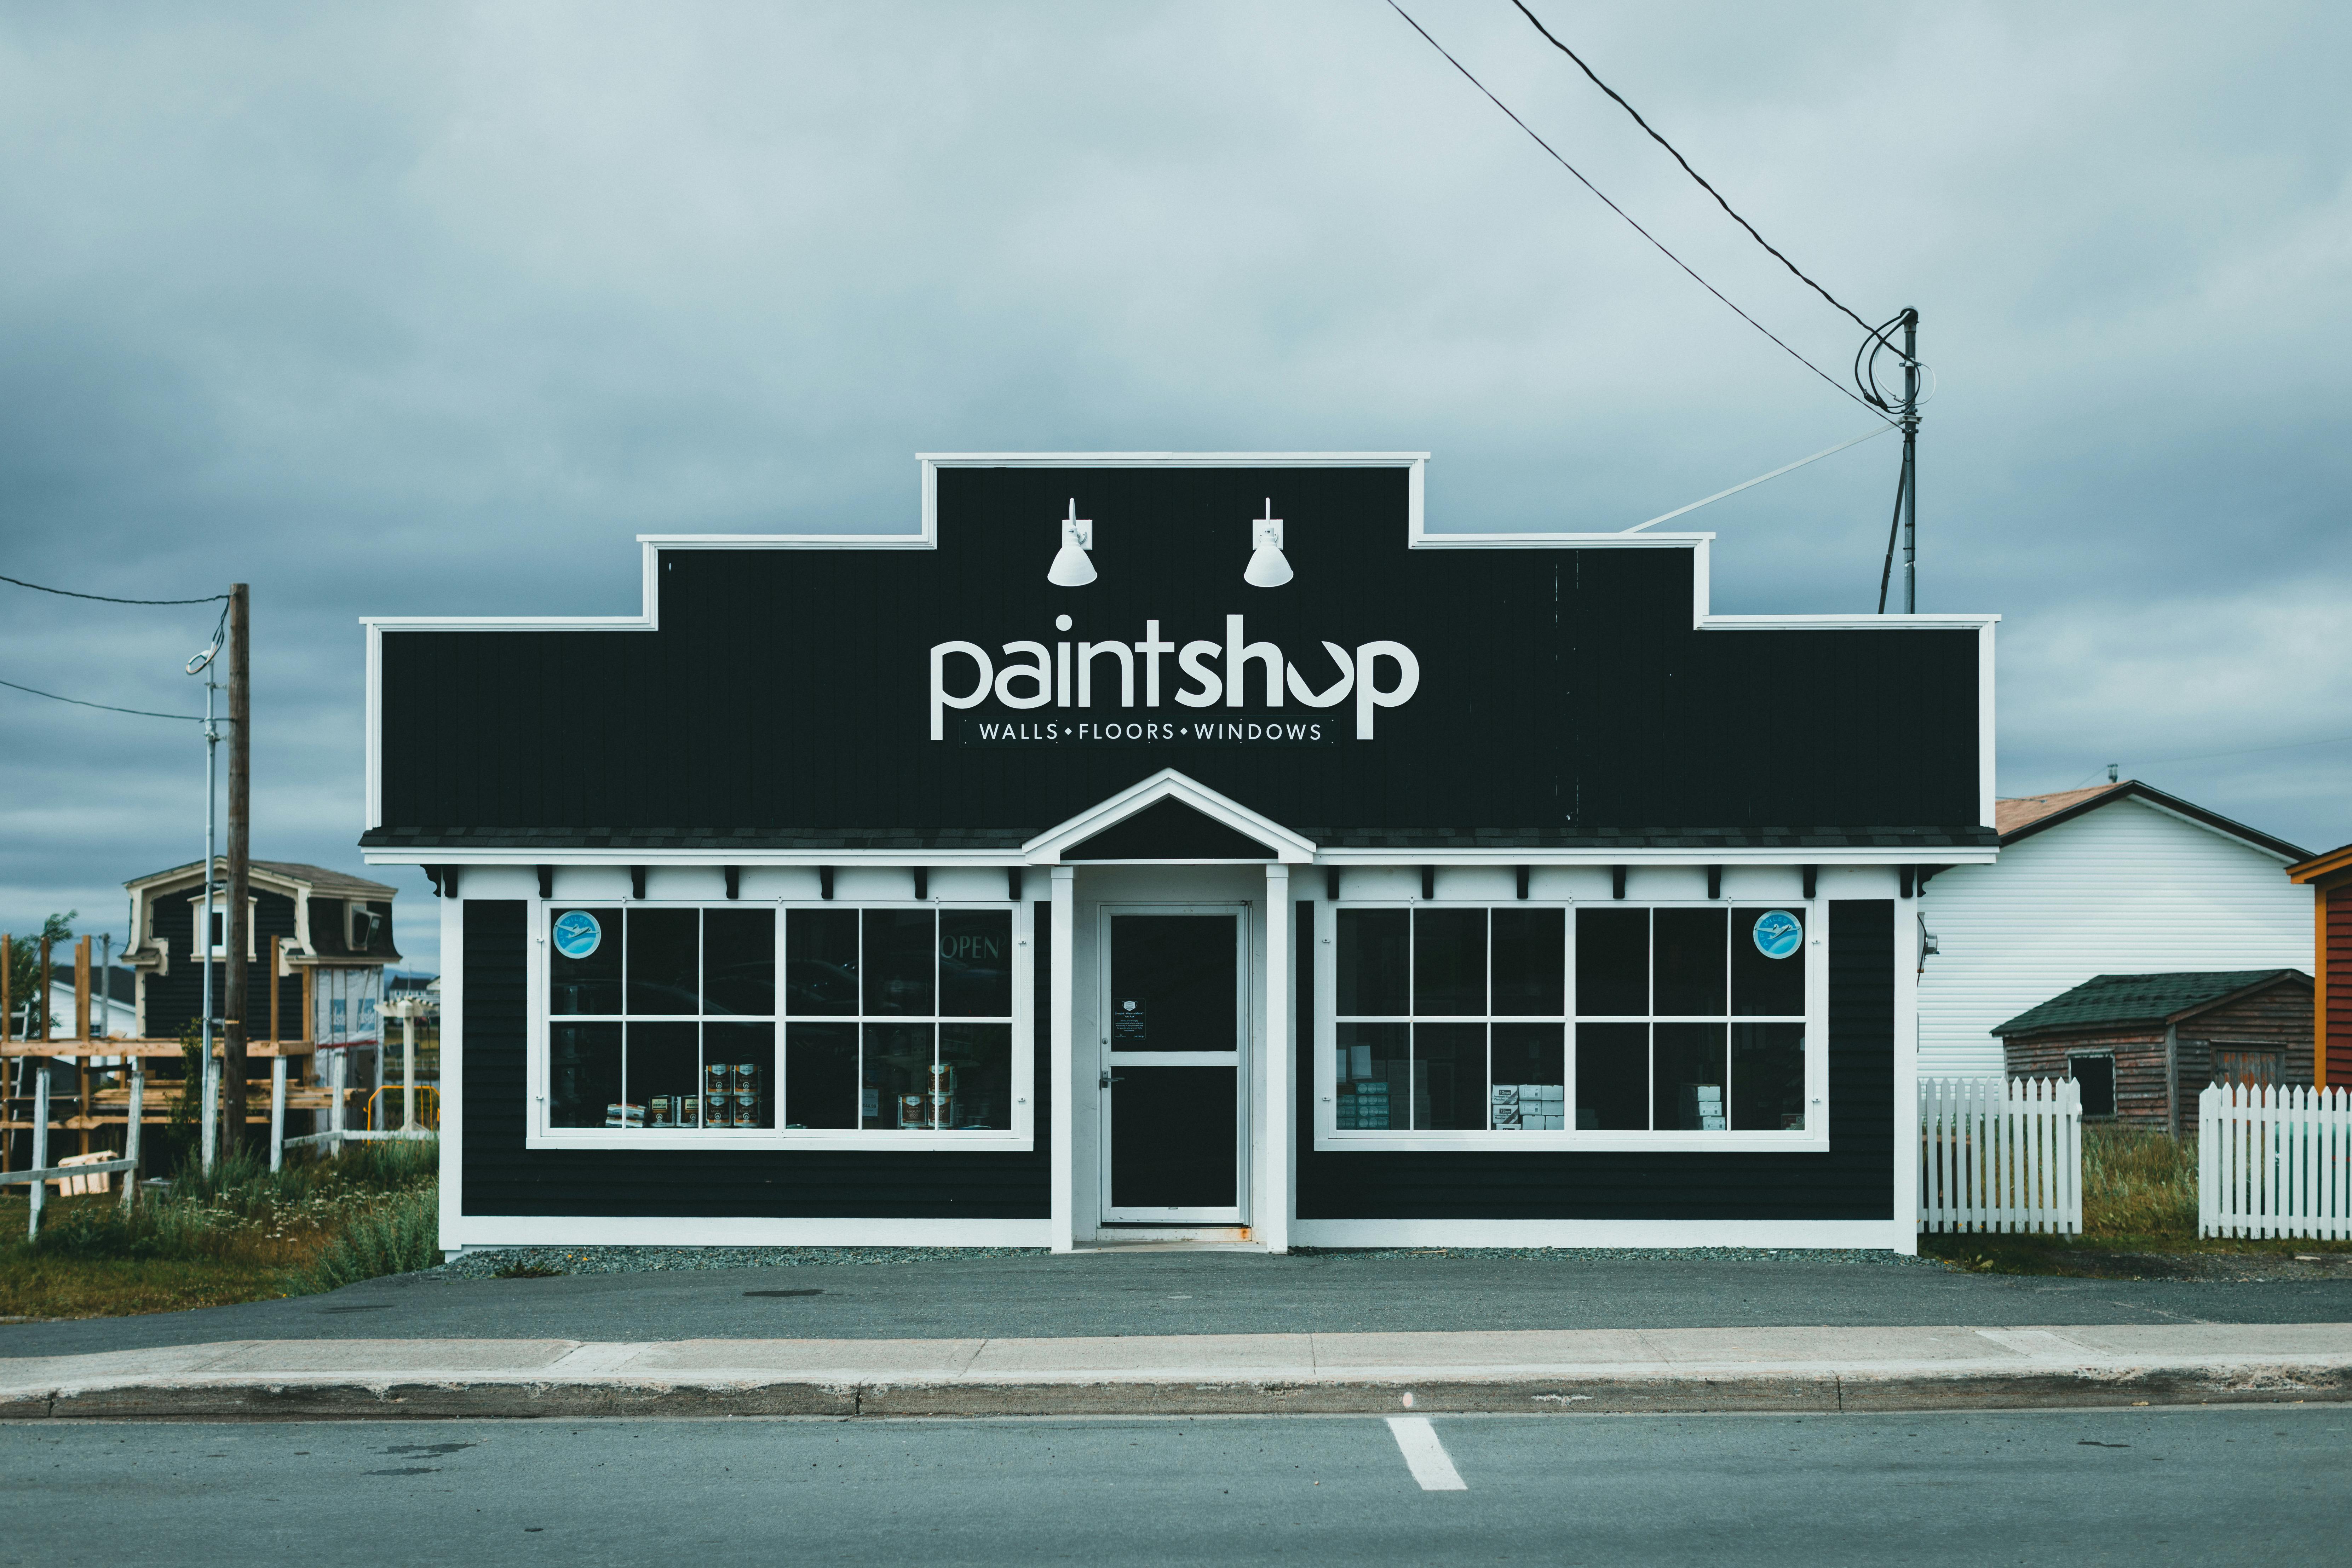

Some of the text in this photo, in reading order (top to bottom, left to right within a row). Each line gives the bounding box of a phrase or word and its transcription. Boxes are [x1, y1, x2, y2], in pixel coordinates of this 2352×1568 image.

[931, 614, 1420, 740] paintshop
[979, 724, 1321, 740] WALLS FLOORS WINDOWS
[1760, 917, 1788, 946] AIR MILES
[939, 935, 999, 959] OPEN
